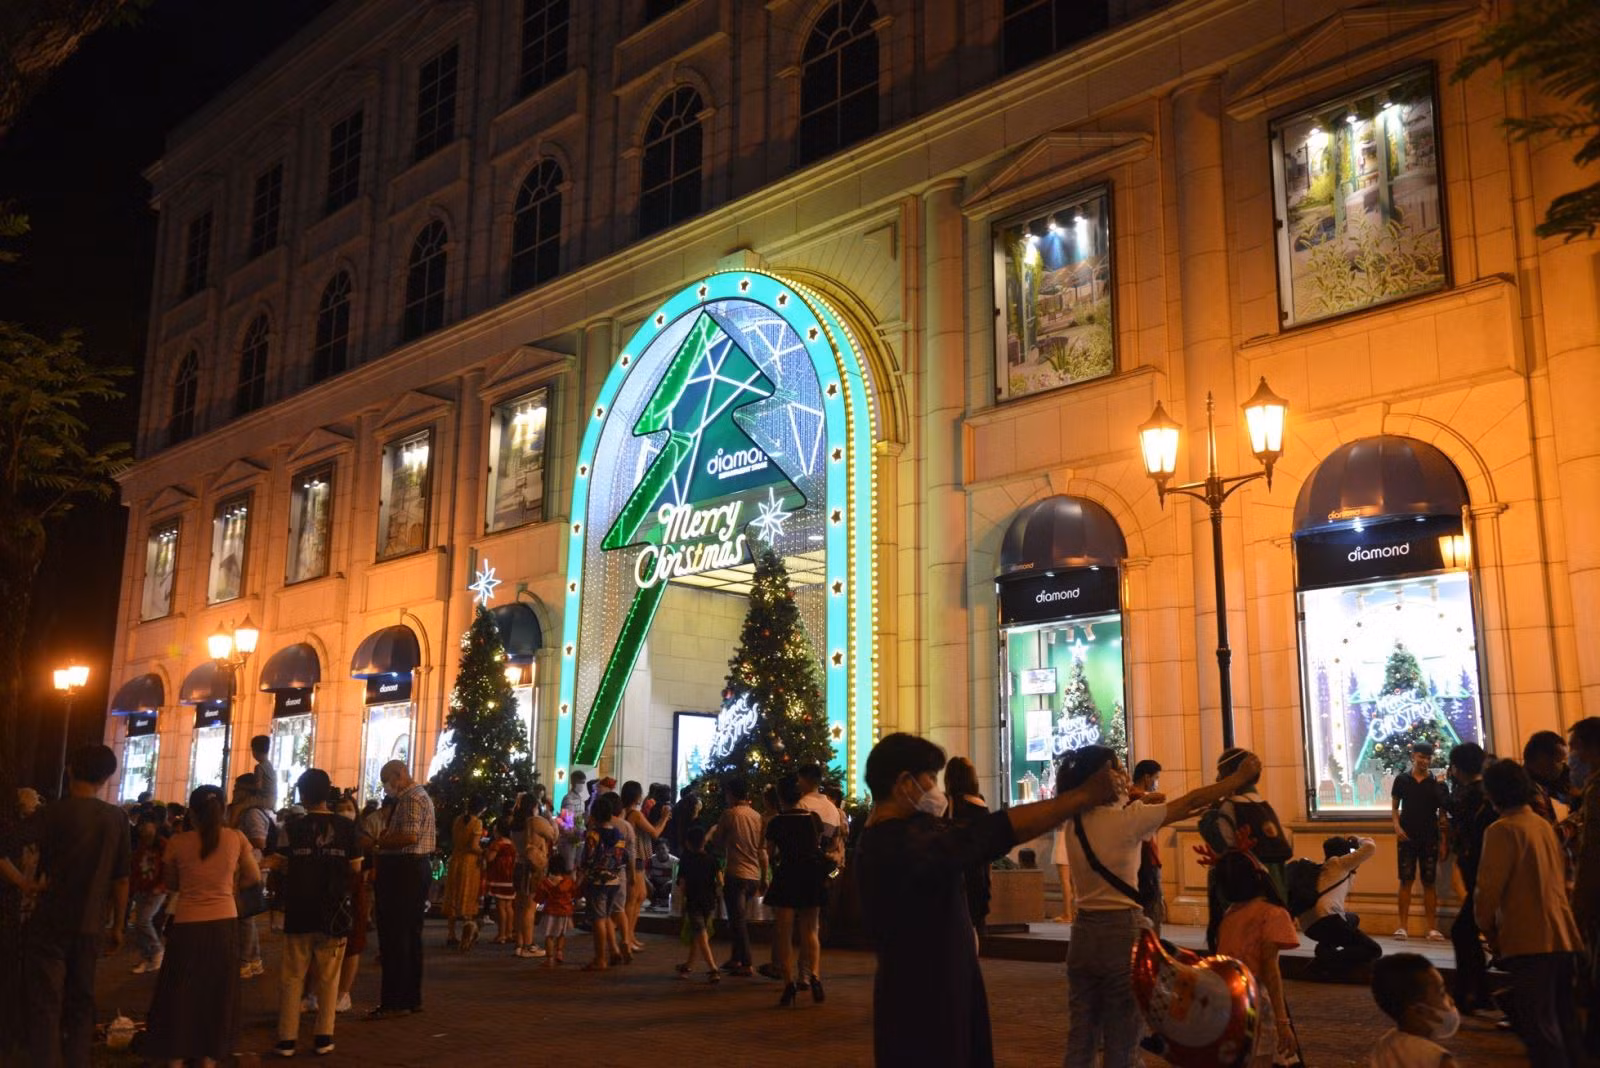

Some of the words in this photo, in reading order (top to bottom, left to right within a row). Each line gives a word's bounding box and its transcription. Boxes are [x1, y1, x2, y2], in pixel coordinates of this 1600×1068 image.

[658, 500, 743, 544] Merry
[635, 534, 746, 589] Christmas
[1347, 542, 1410, 562] diamond
[1035, 587, 1080, 603] diamond
